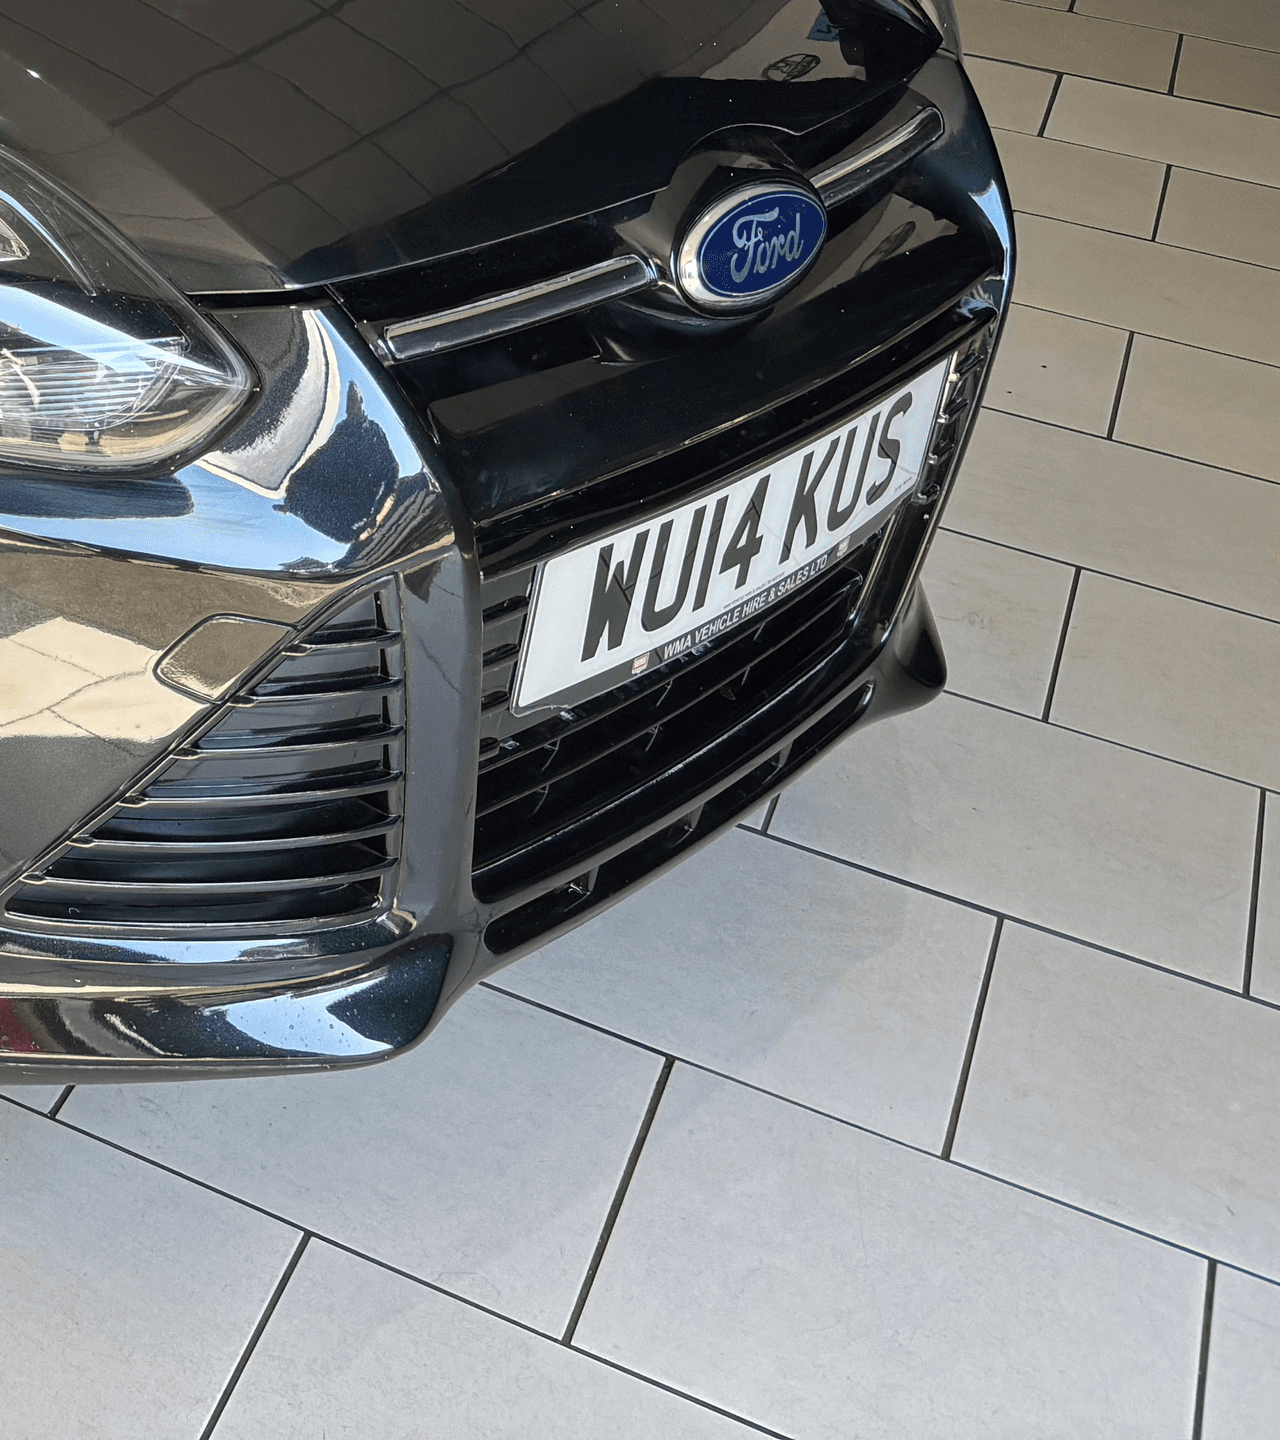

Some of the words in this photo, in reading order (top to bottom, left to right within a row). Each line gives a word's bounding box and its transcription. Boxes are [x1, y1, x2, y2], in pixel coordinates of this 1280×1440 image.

[730, 205, 806, 284] Ford
[580, 476, 773, 664] WU14
[777, 390, 915, 567] KUS
[664, 639, 691, 660] WMA
[695, 608, 740, 643] VEHICLE
[741, 595, 766, 618] HIRE
[767, 589, 776, 603] &
[777, 567, 809, 596] SALES
[810, 555, 828, 577] LTD
